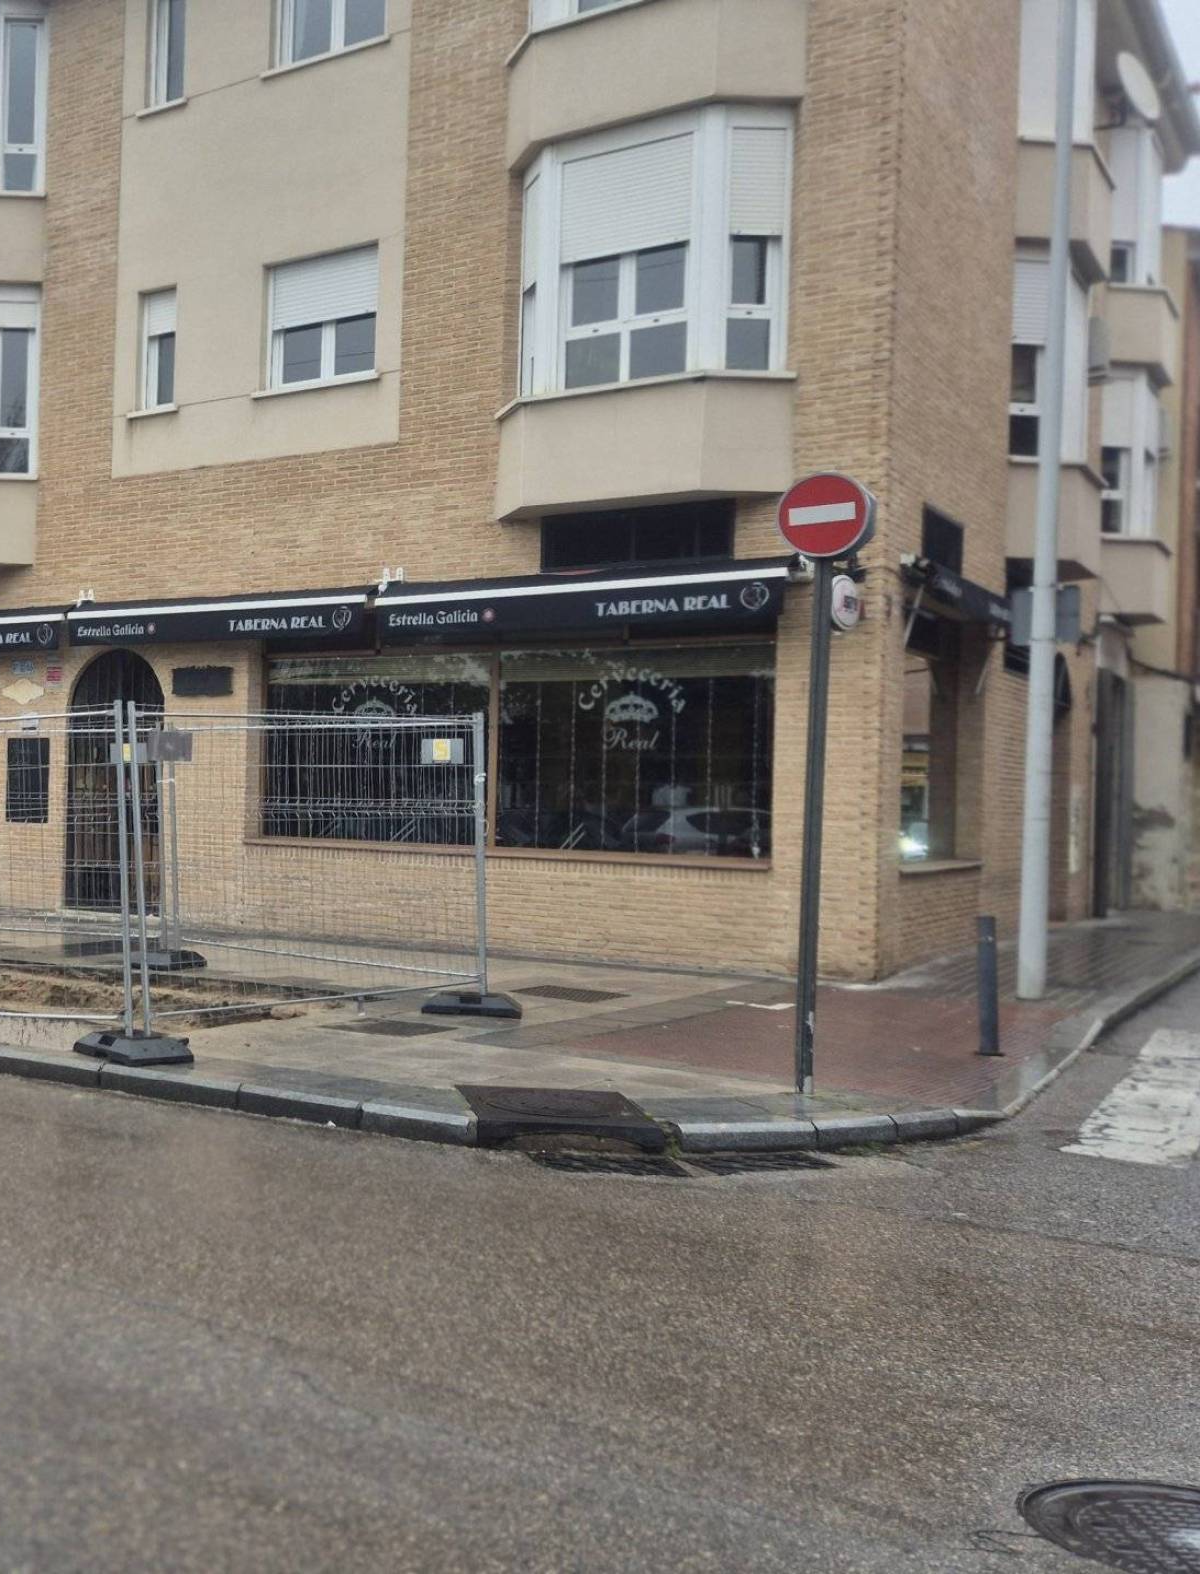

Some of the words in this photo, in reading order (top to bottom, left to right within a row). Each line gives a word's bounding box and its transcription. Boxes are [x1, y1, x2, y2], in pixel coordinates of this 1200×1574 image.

[595, 598, 679, 617] TABERNA
[683, 594, 731, 612] REAL
[228, 617, 288, 632] TABERNA
[290, 615, 327, 629] REAL
[386, 612, 434, 627] Estrella
[436, 609, 479, 625] Galicia
[5, 631, 32, 644] REAL
[77, 625, 112, 637] Estrella
[112, 623, 145, 636] Galicia
[603, 727, 660, 751] Real
